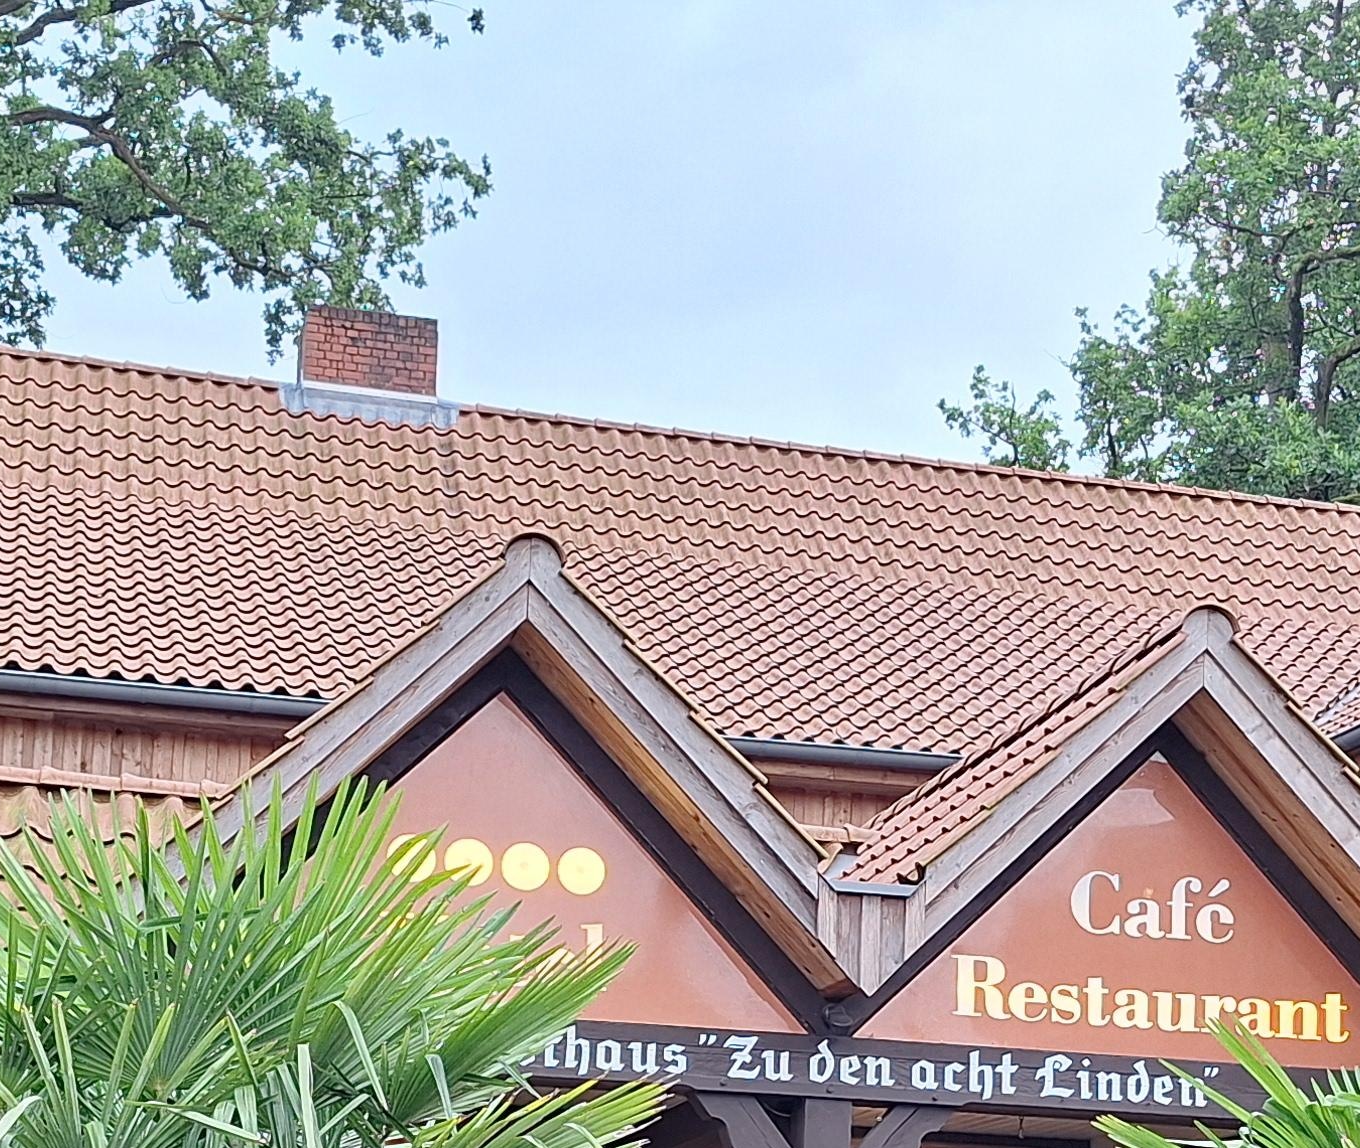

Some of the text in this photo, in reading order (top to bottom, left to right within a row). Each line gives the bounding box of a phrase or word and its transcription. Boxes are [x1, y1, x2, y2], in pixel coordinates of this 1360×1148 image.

[1070, 870, 1236, 944] Café
[950, 953, 1351, 1043] Restaurant
[808, 1038, 896, 1087] den
[910, 1050, 1018, 1101] acht
